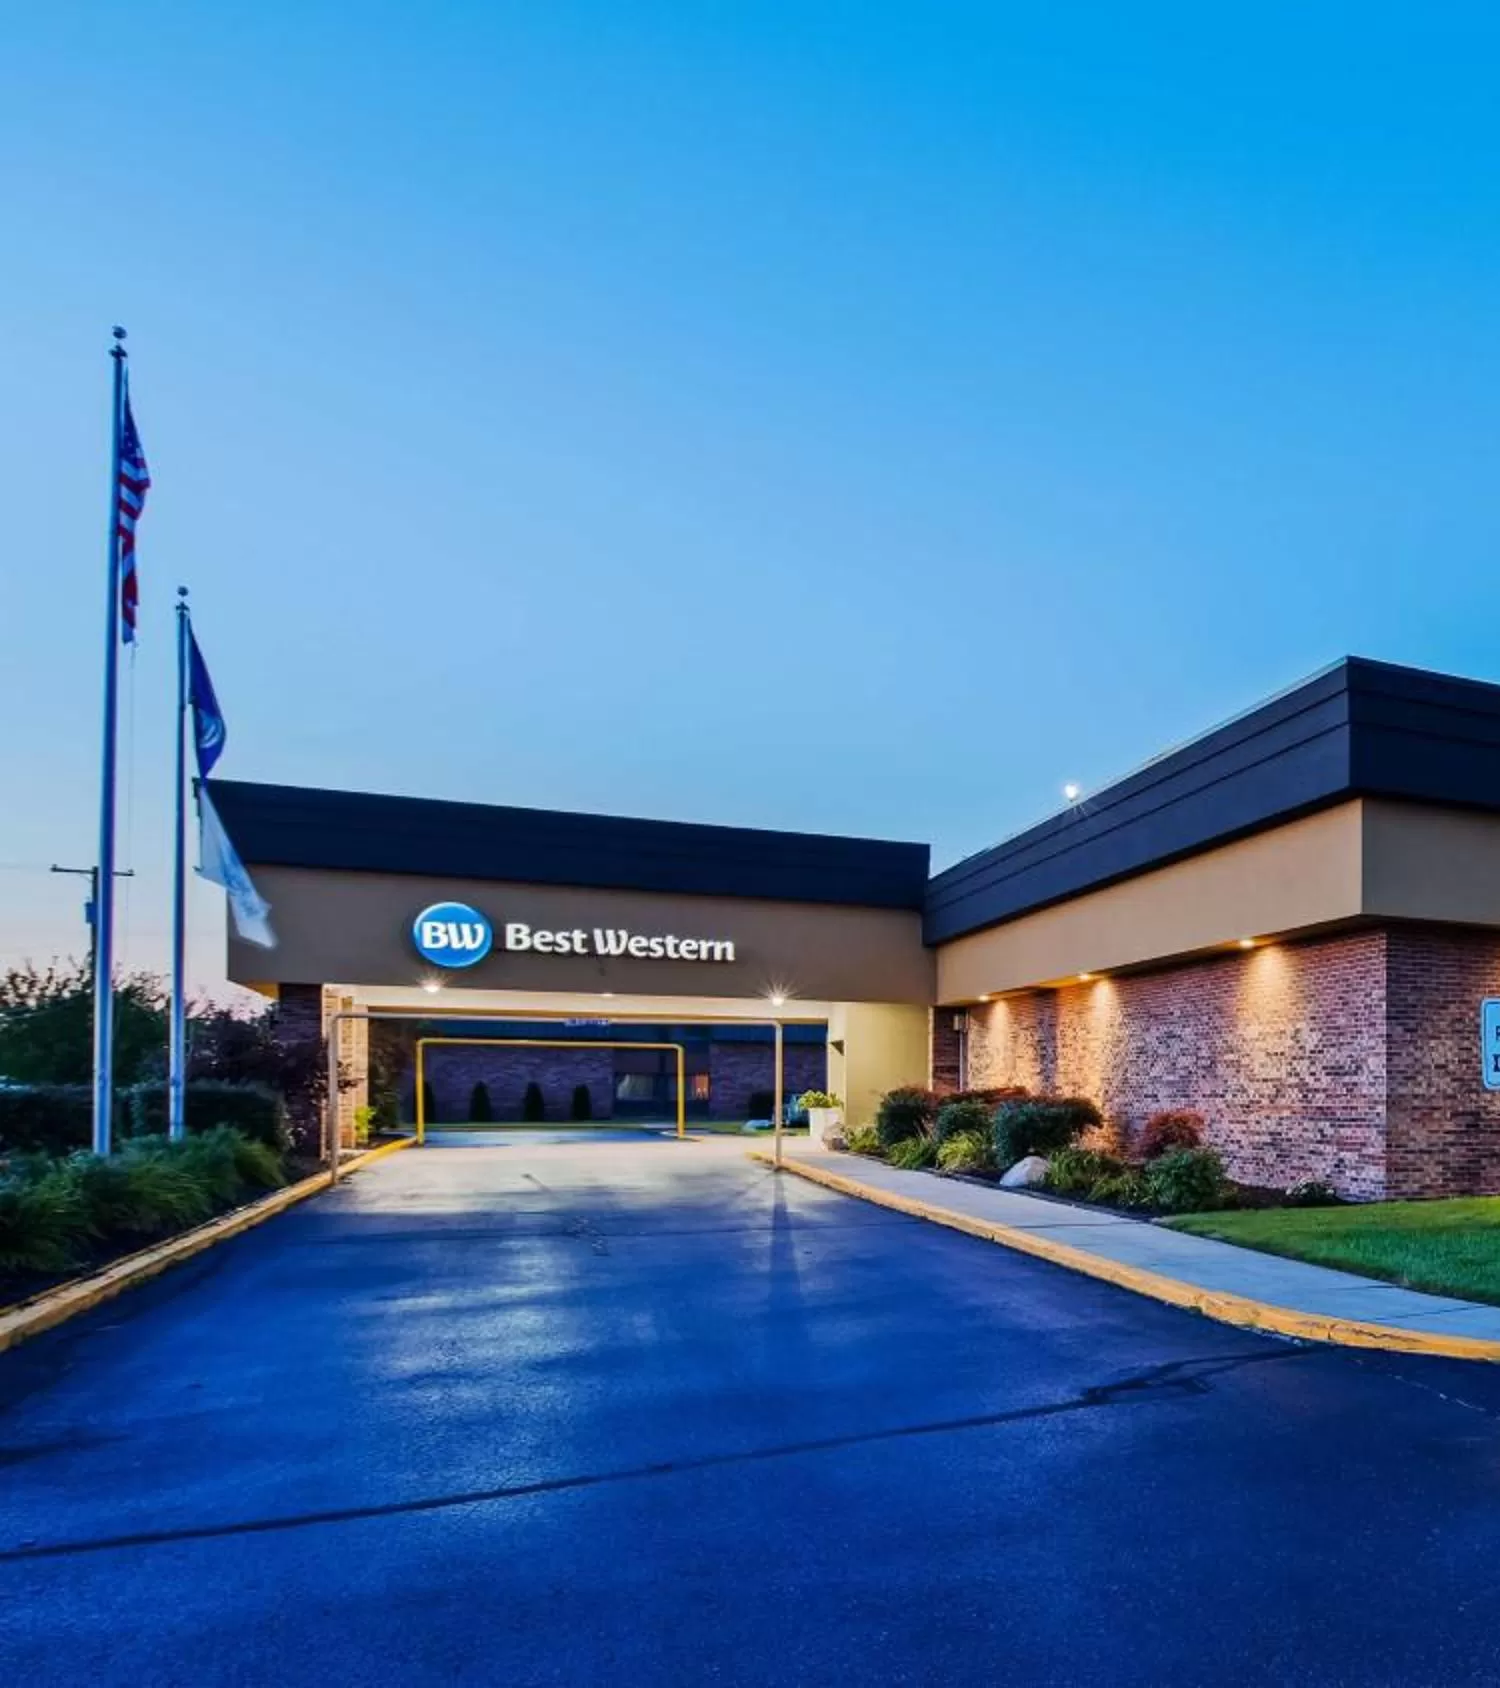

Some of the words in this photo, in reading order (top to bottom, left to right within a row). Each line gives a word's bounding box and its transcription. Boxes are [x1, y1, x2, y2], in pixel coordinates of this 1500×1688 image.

[422, 921, 485, 950] BW
[505, 923, 588, 954] Best
[593, 928, 735, 961] Western
